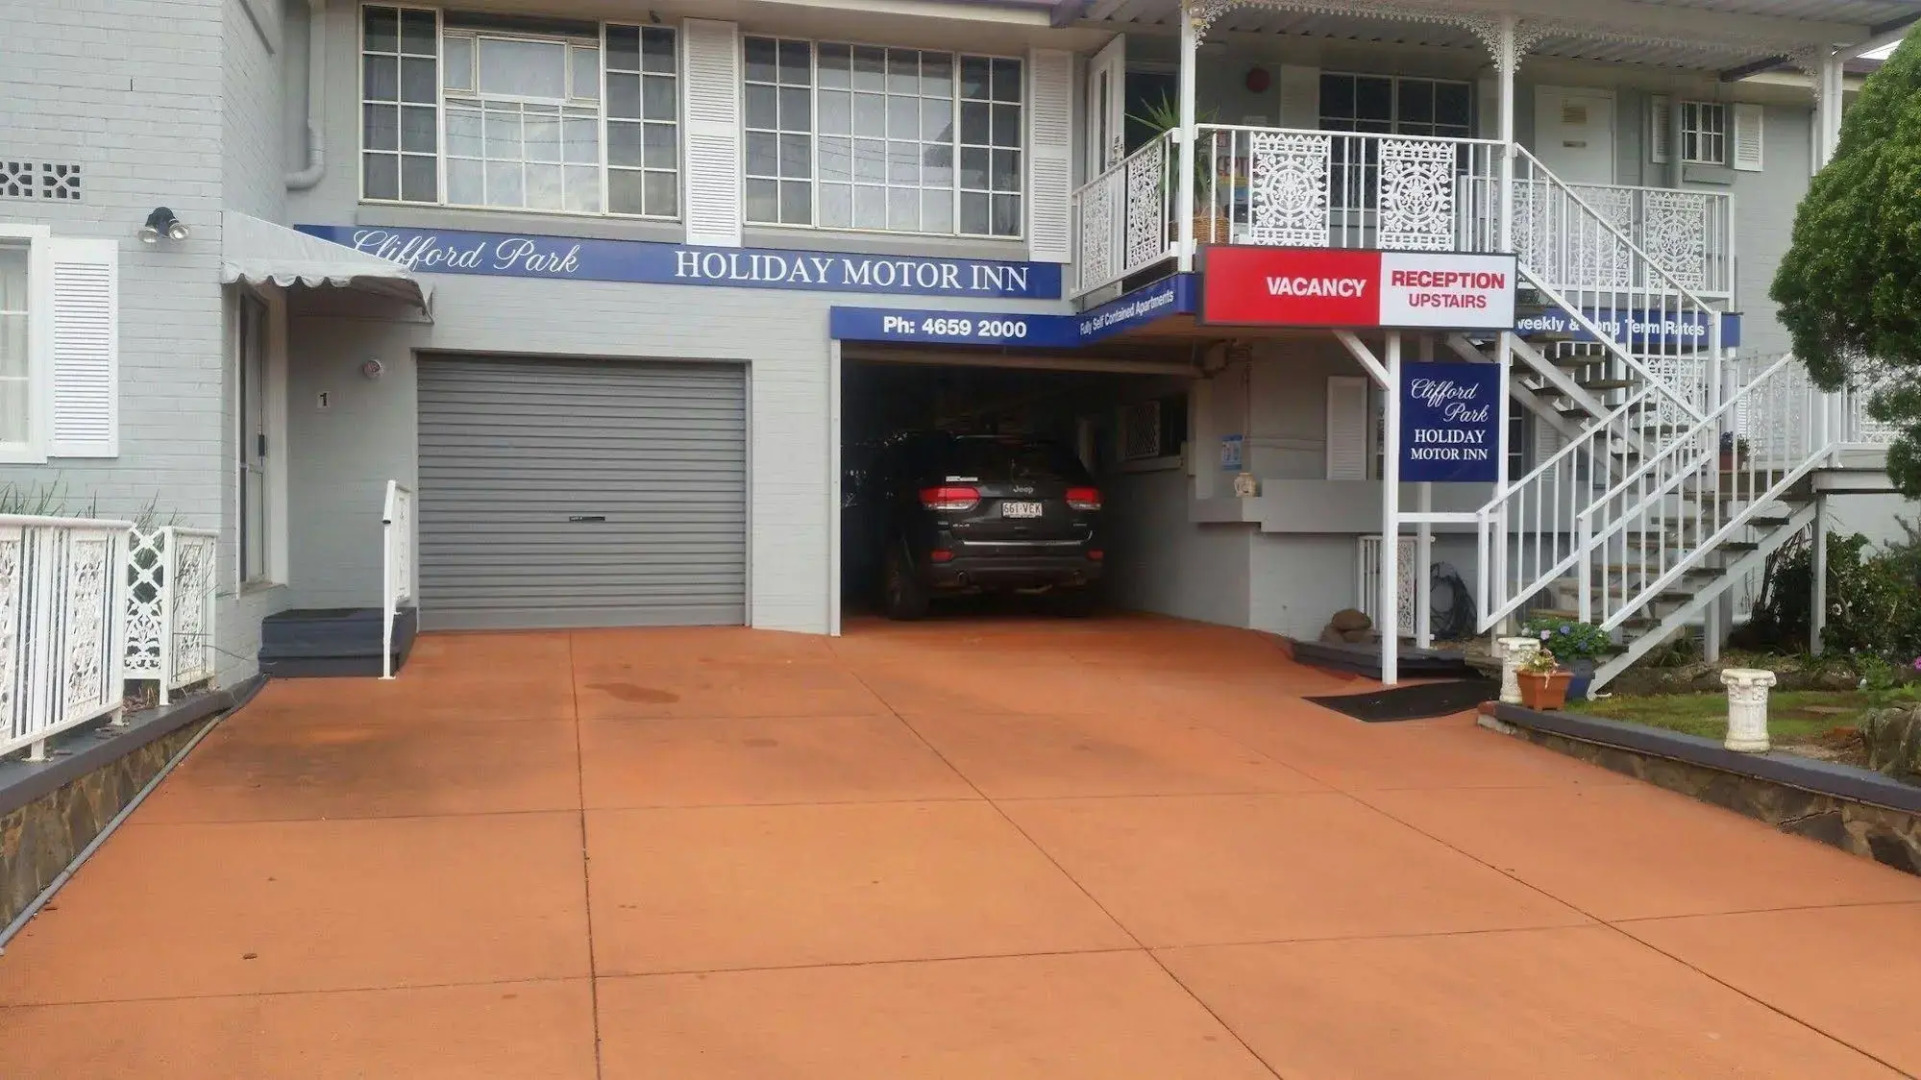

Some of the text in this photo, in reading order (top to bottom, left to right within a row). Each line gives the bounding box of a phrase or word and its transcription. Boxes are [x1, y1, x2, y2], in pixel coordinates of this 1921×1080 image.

[354, 230, 580, 273] Clifford Park
[675, 251, 1029, 291] HOLIDAY MOTOR INN
[1391, 270, 1505, 290] RECEPTION
[1266, 276, 1367, 298] VACANCY
[1408, 293, 1487, 309] UPSTAIRS
[1080, 289, 1175, 336] Fully Self Contained Apartments
[883, 316, 1027, 339] Ph: 4659 2000
[1569, 318, 1580, 331] &
[1586, 318, 1620, 336] ong
[1665, 321, 1705, 336] Rates
[320, 392, 328, 407] 1
[1411, 378, 1480, 408] Clifford
[1443, 402, 1490, 422] Park
[1414, 429, 1486, 443] HOLIDAY
[1410, 448, 1489, 460] MOTOR INN
[1012, 485, 1034, 495] Jeep
